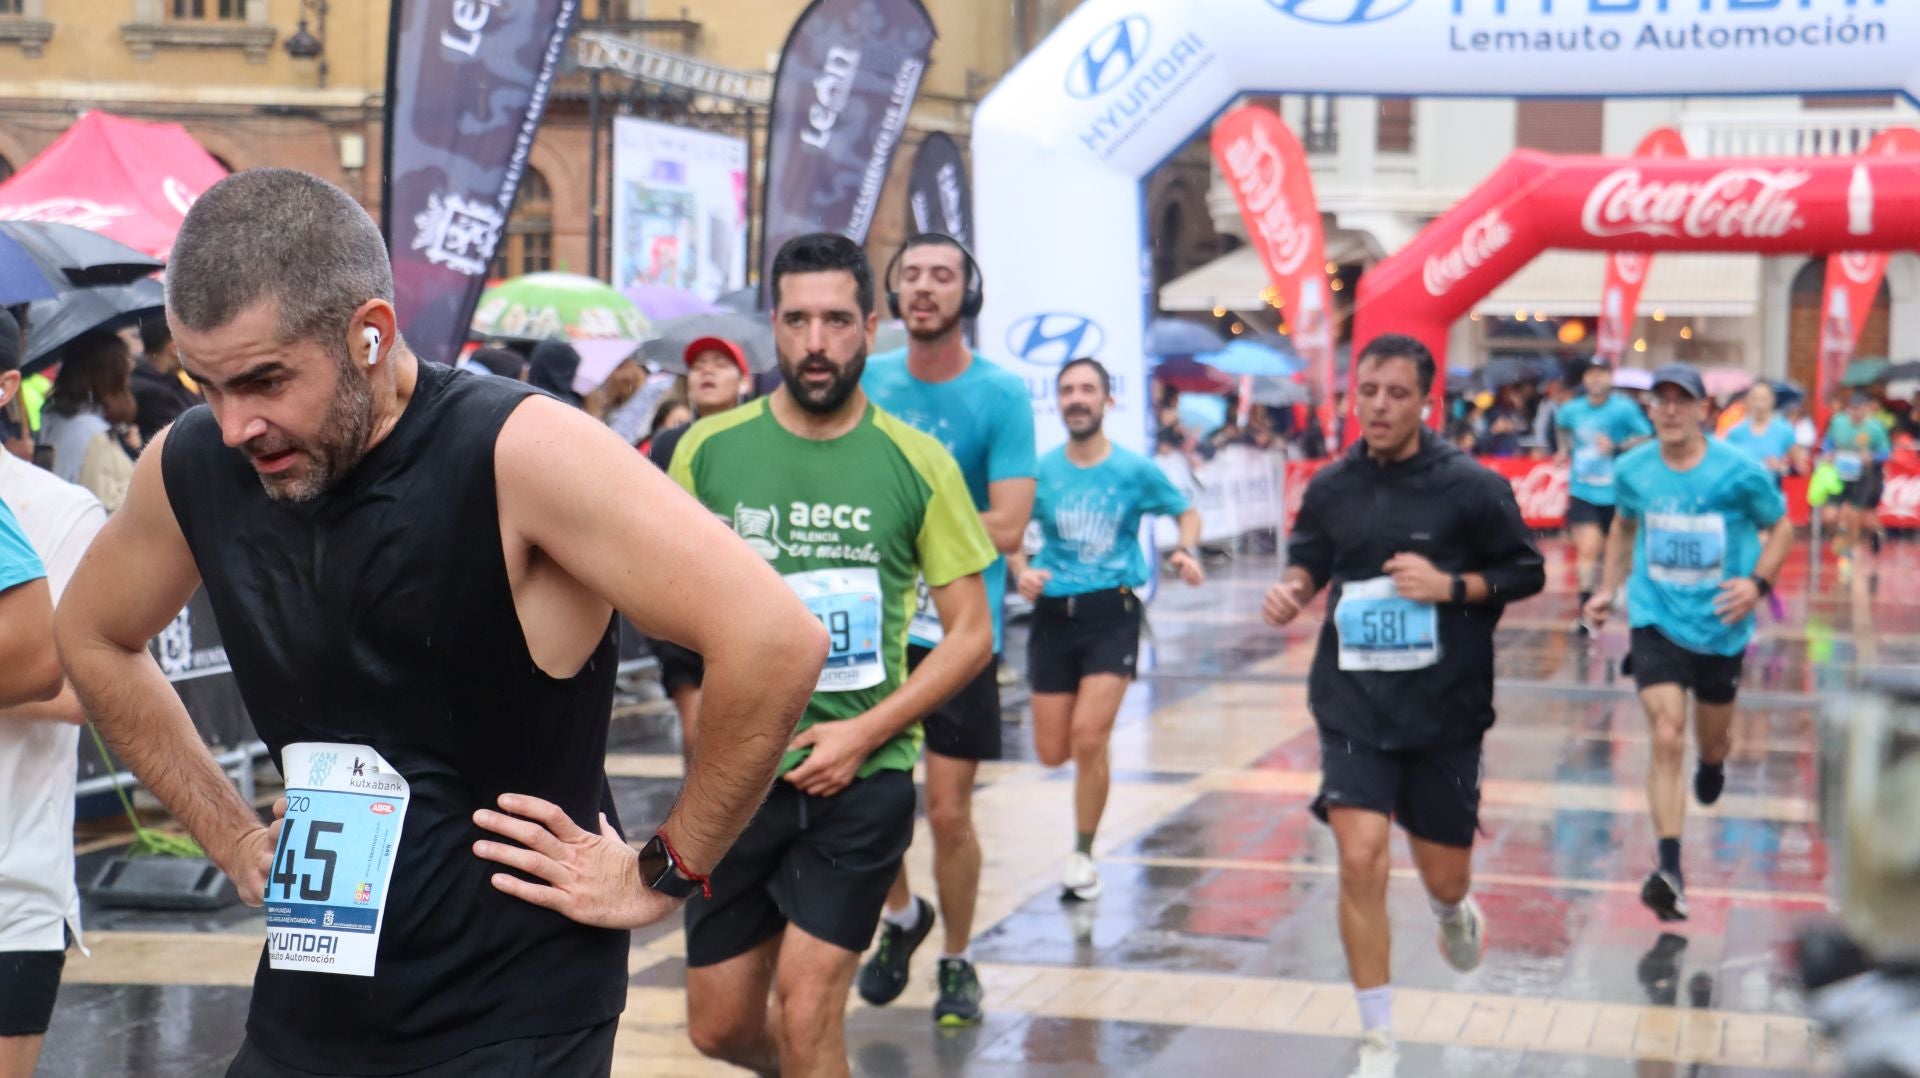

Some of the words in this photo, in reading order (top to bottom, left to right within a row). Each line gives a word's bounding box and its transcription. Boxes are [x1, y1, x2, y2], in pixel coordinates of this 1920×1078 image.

[441, 0, 501, 56] Le
[1449, 24, 1621, 52] Lemauto
[1635, 14, 1886, 50] Automoción
[801, 48, 862, 150] León
[1078, 32, 1207, 151] HYUNDAI
[789, 500, 872, 532] aecc
[787, 543, 813, 558] en
[816, 542, 881, 564] marcha
[789, 530, 840, 543] PALENCIA
[1666, 539, 1703, 567] 316
[815, 610, 850, 653] 9
[1362, 610, 1407, 643] 581
[349, 777, 402, 792] kutxabank
[264, 818, 345, 902] 45
[269, 952, 284, 961] auto
[284, 952, 335, 965] Automoción
